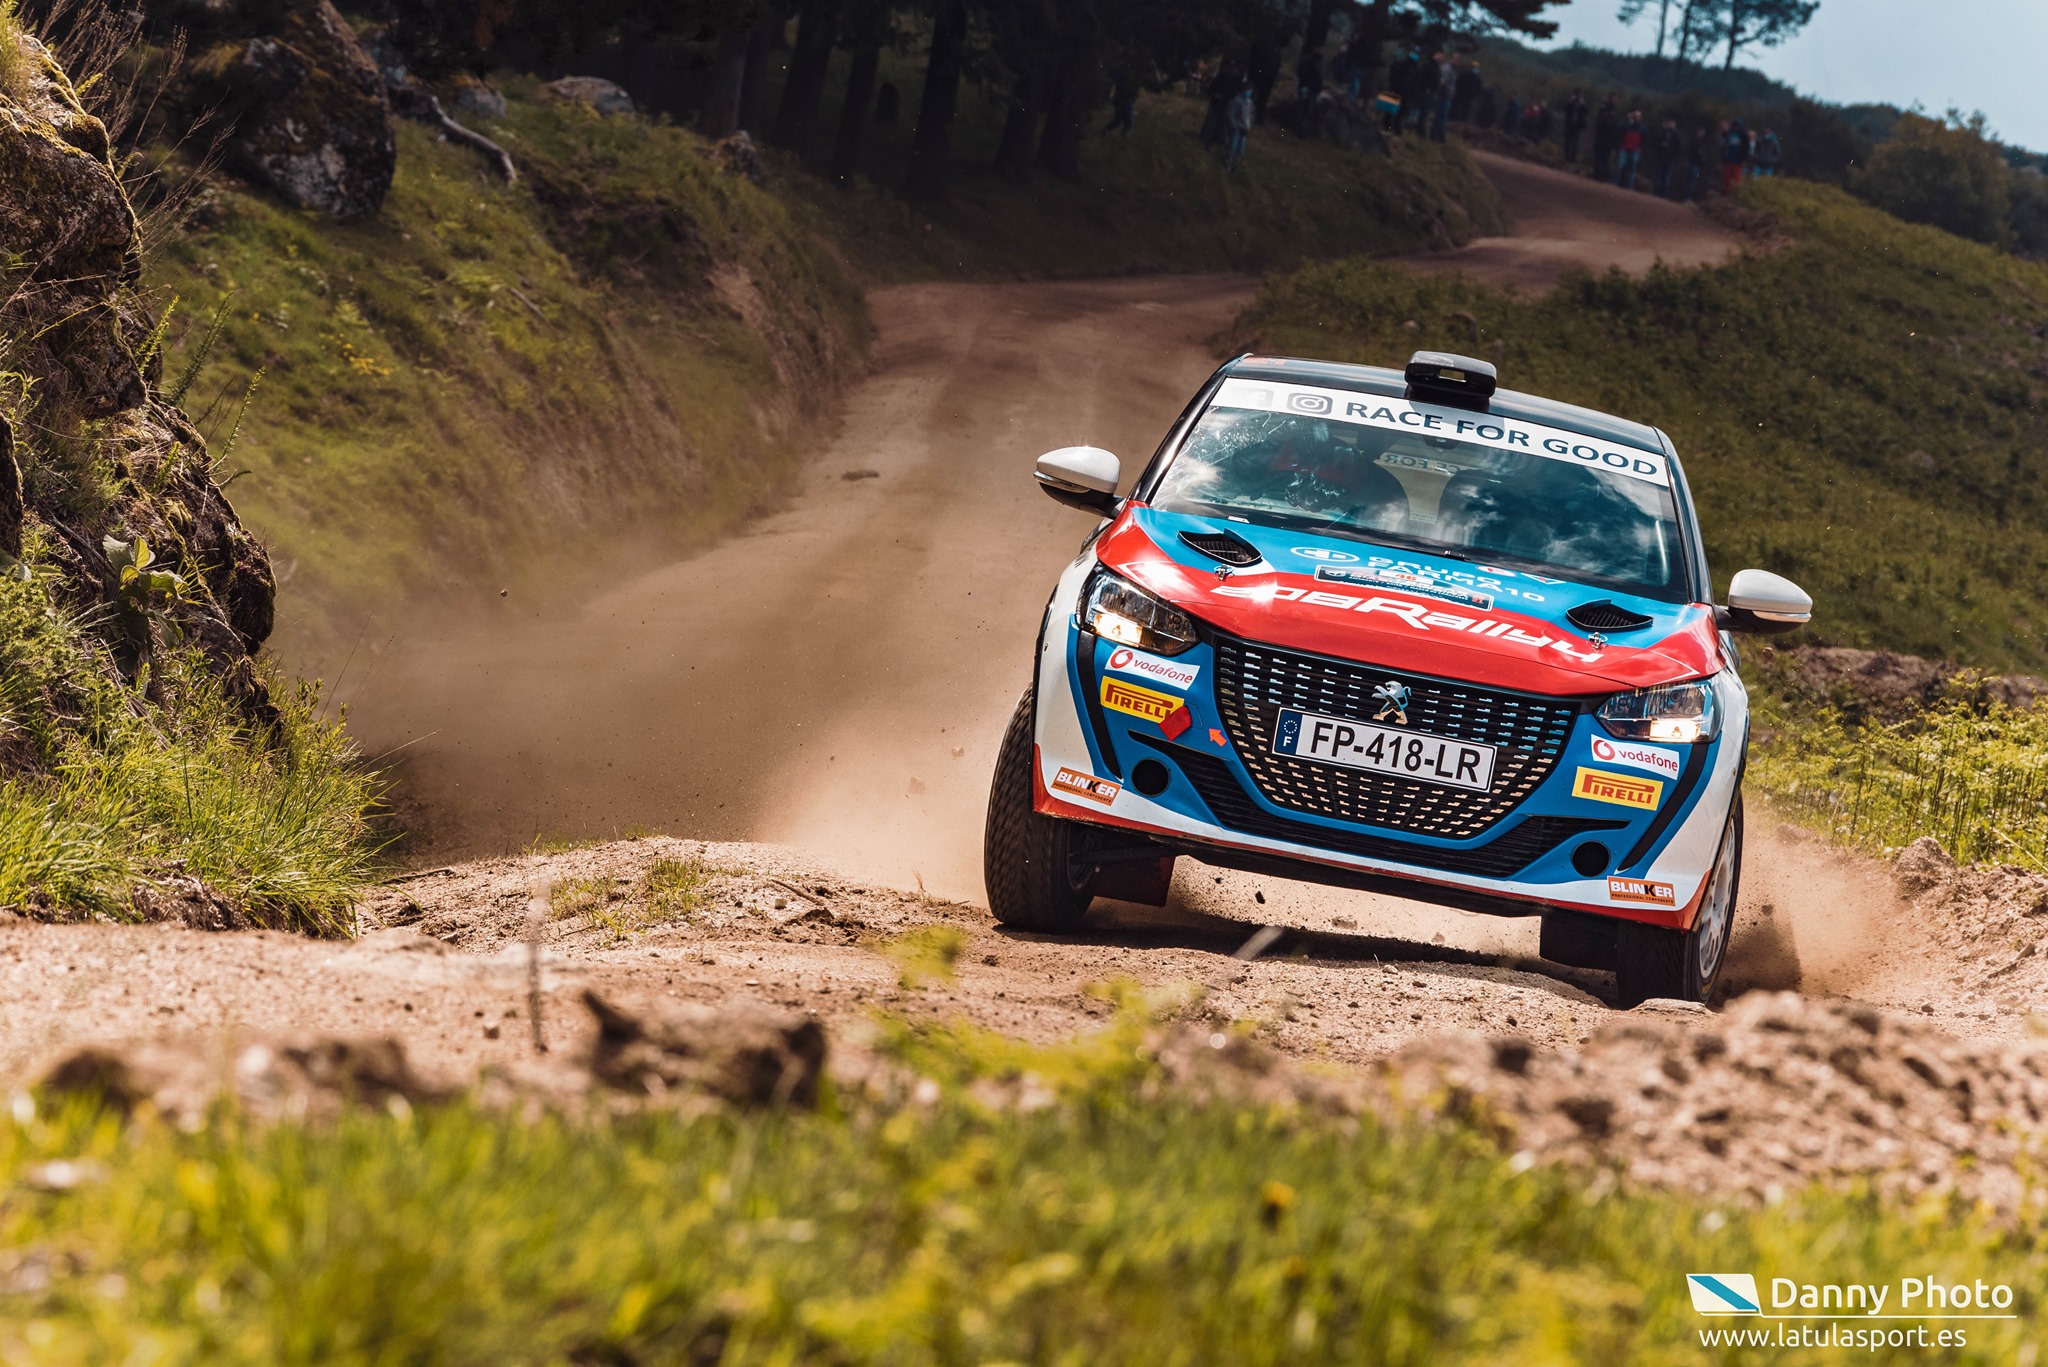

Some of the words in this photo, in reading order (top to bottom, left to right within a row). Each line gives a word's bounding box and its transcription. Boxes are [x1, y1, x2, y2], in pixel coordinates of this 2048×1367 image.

[1346, 402, 1443, 430] RACE
[1456, 420, 1530, 447] FOR
[1542, 439, 1657, 476] GOOD
[1367, 561, 1545, 602] FARMA10
[1368, 556, 1502, 586] GRUPO
[1134, 660, 1193, 684] vodafone
[1283, 736, 1292, 747] F
[1310, 721, 1481, 783] FP-418-LR
[1619, 751, 1678, 772] vodafone
[1056, 771, 1117, 798] BLINKER
[1582, 774, 1655, 804] PIRELLI
[1610, 881, 1673, 898] BLINKER
